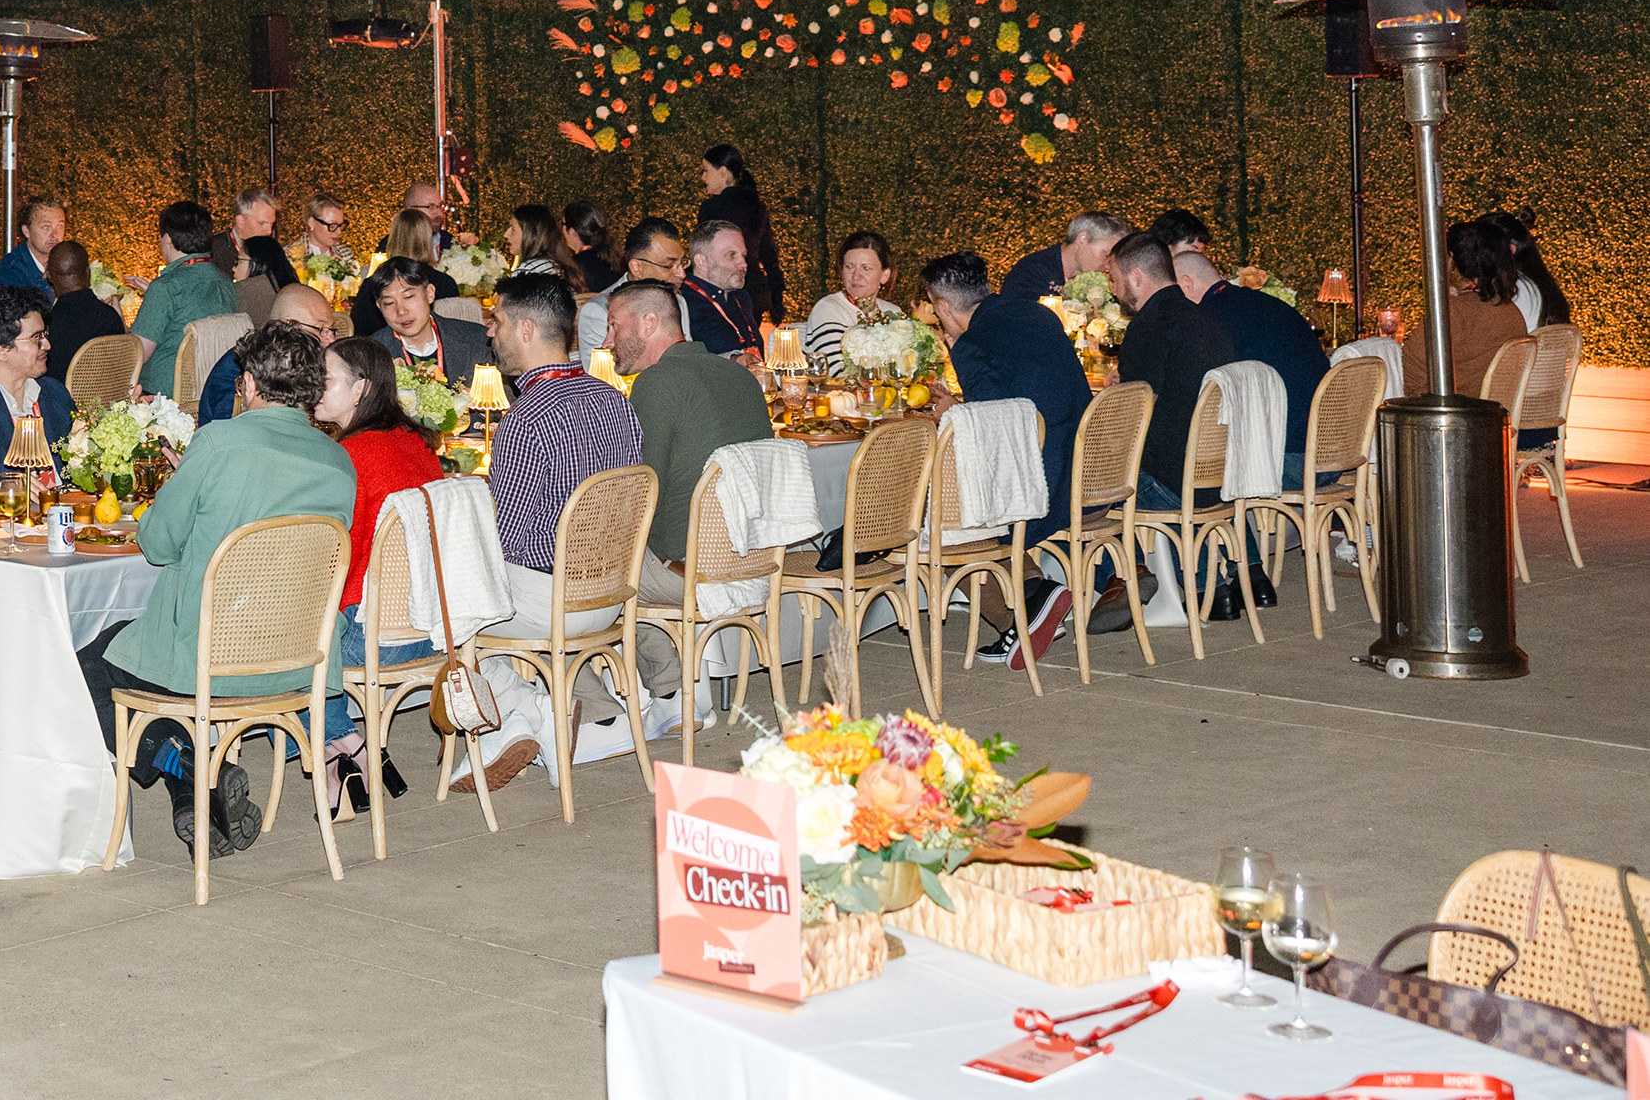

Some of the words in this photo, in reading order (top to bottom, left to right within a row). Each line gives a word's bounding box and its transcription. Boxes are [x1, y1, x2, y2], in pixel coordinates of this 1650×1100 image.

[671, 815, 775, 875] Welcome
[686, 865, 789, 913] Check-in
[702, 940, 745, 965] jasper
